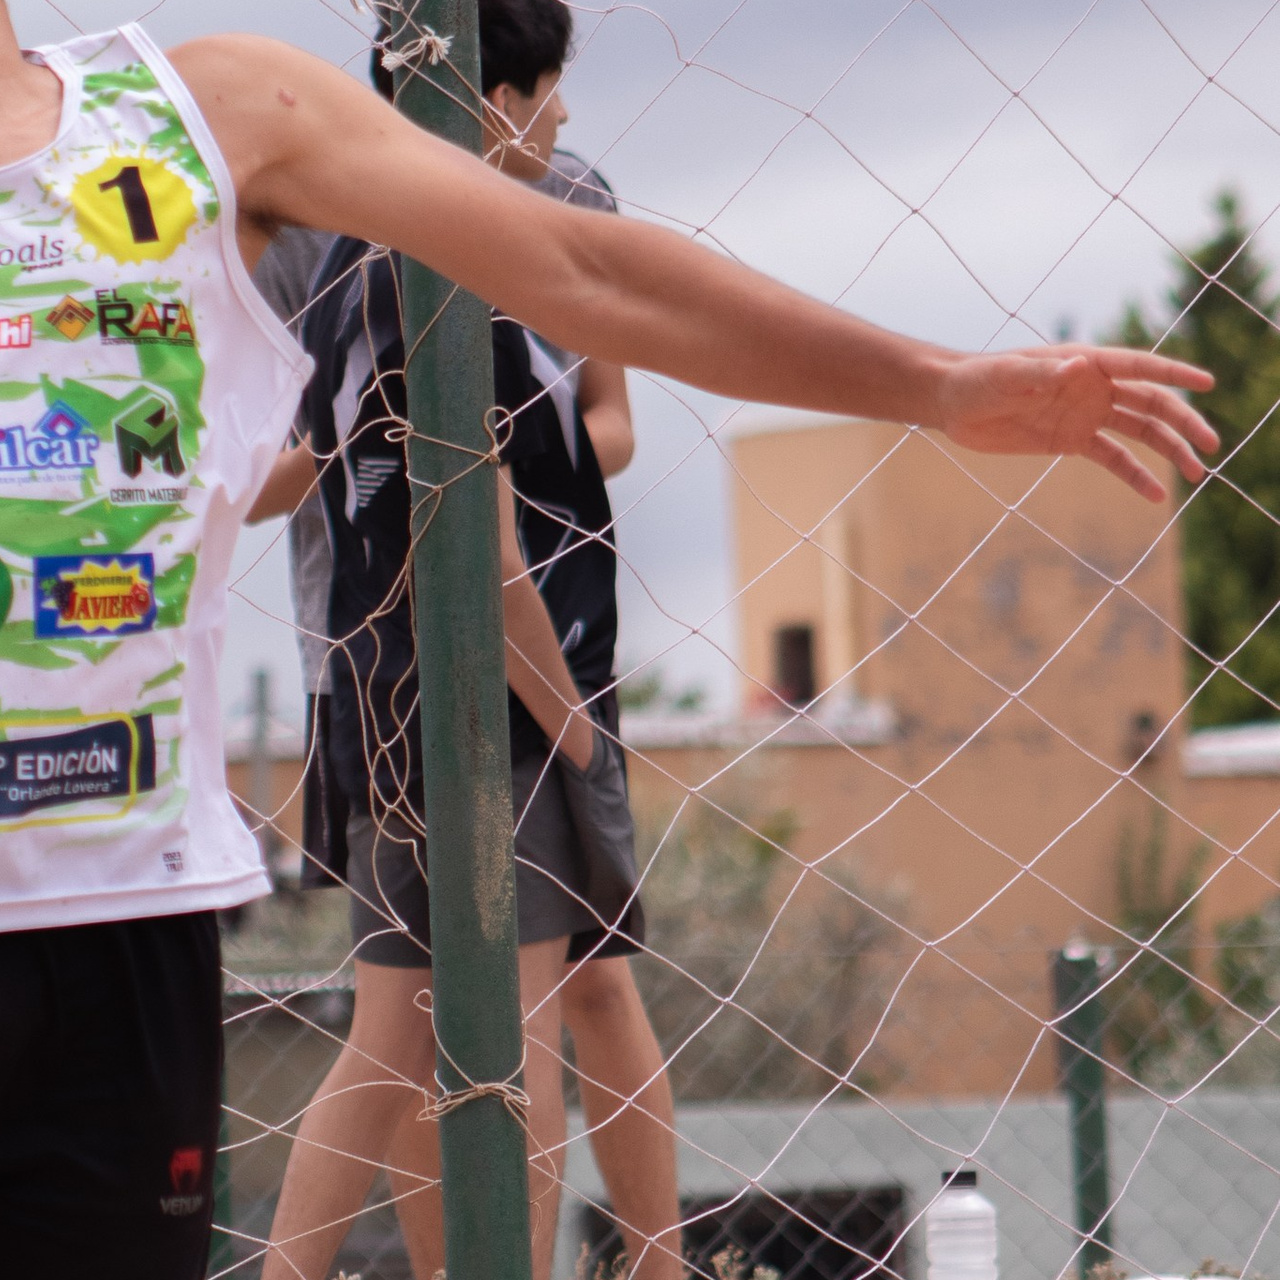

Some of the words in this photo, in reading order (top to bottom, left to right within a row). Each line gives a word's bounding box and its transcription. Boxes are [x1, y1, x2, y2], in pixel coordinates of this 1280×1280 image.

[98, 166, 160, 244] 1
[95, 288, 128, 304] EL
[98, 302, 196, 340] RAFA
[16, 740, 119, 781] EDICIÓN
